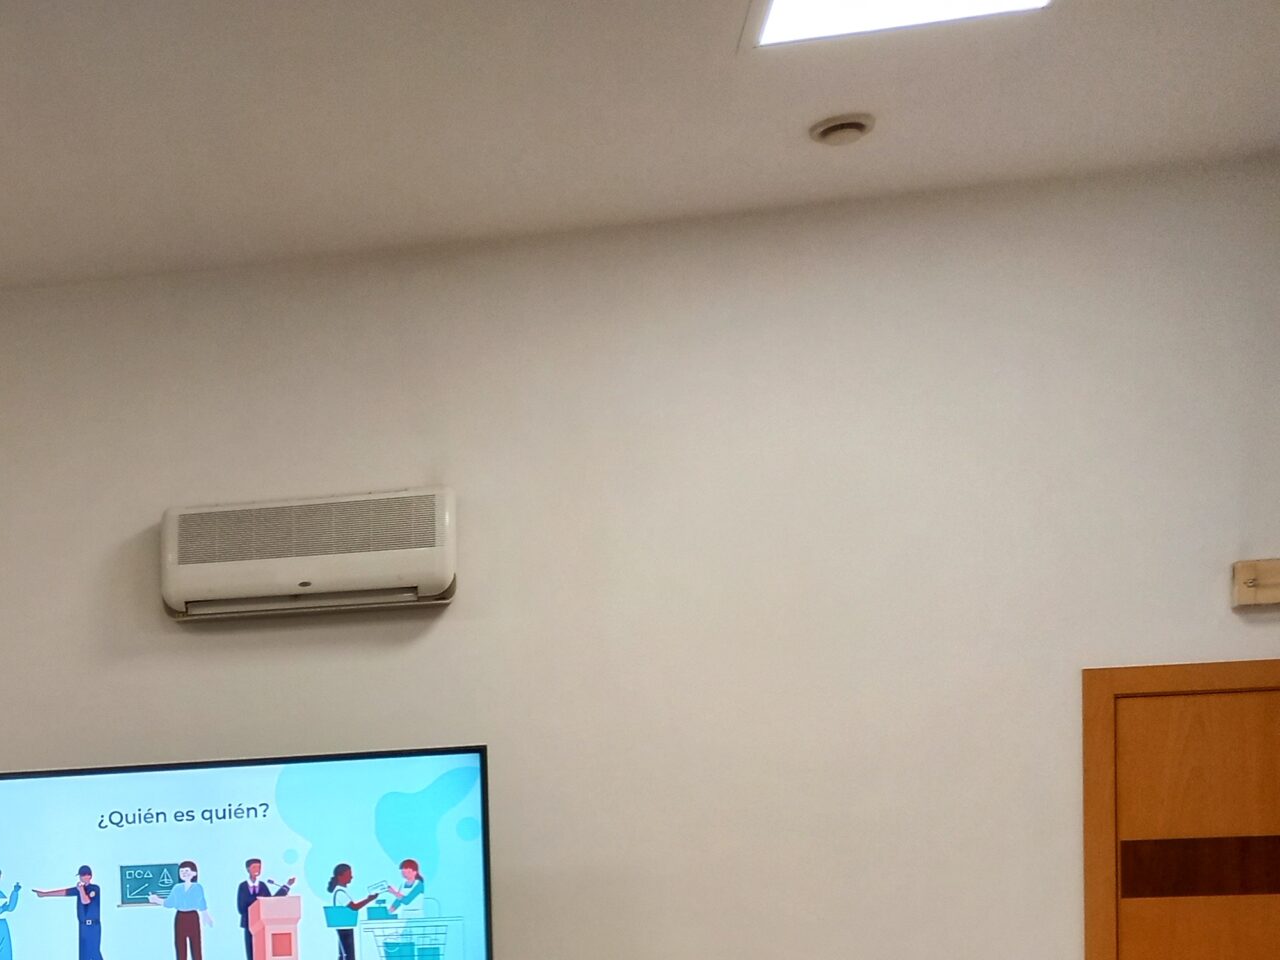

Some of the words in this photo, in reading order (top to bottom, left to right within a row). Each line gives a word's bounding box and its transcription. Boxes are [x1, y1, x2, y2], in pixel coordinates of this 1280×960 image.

[97, 808, 167, 829] ¿Quién
[173, 809, 195, 822] es
[201, 803, 270, 824] quién?
